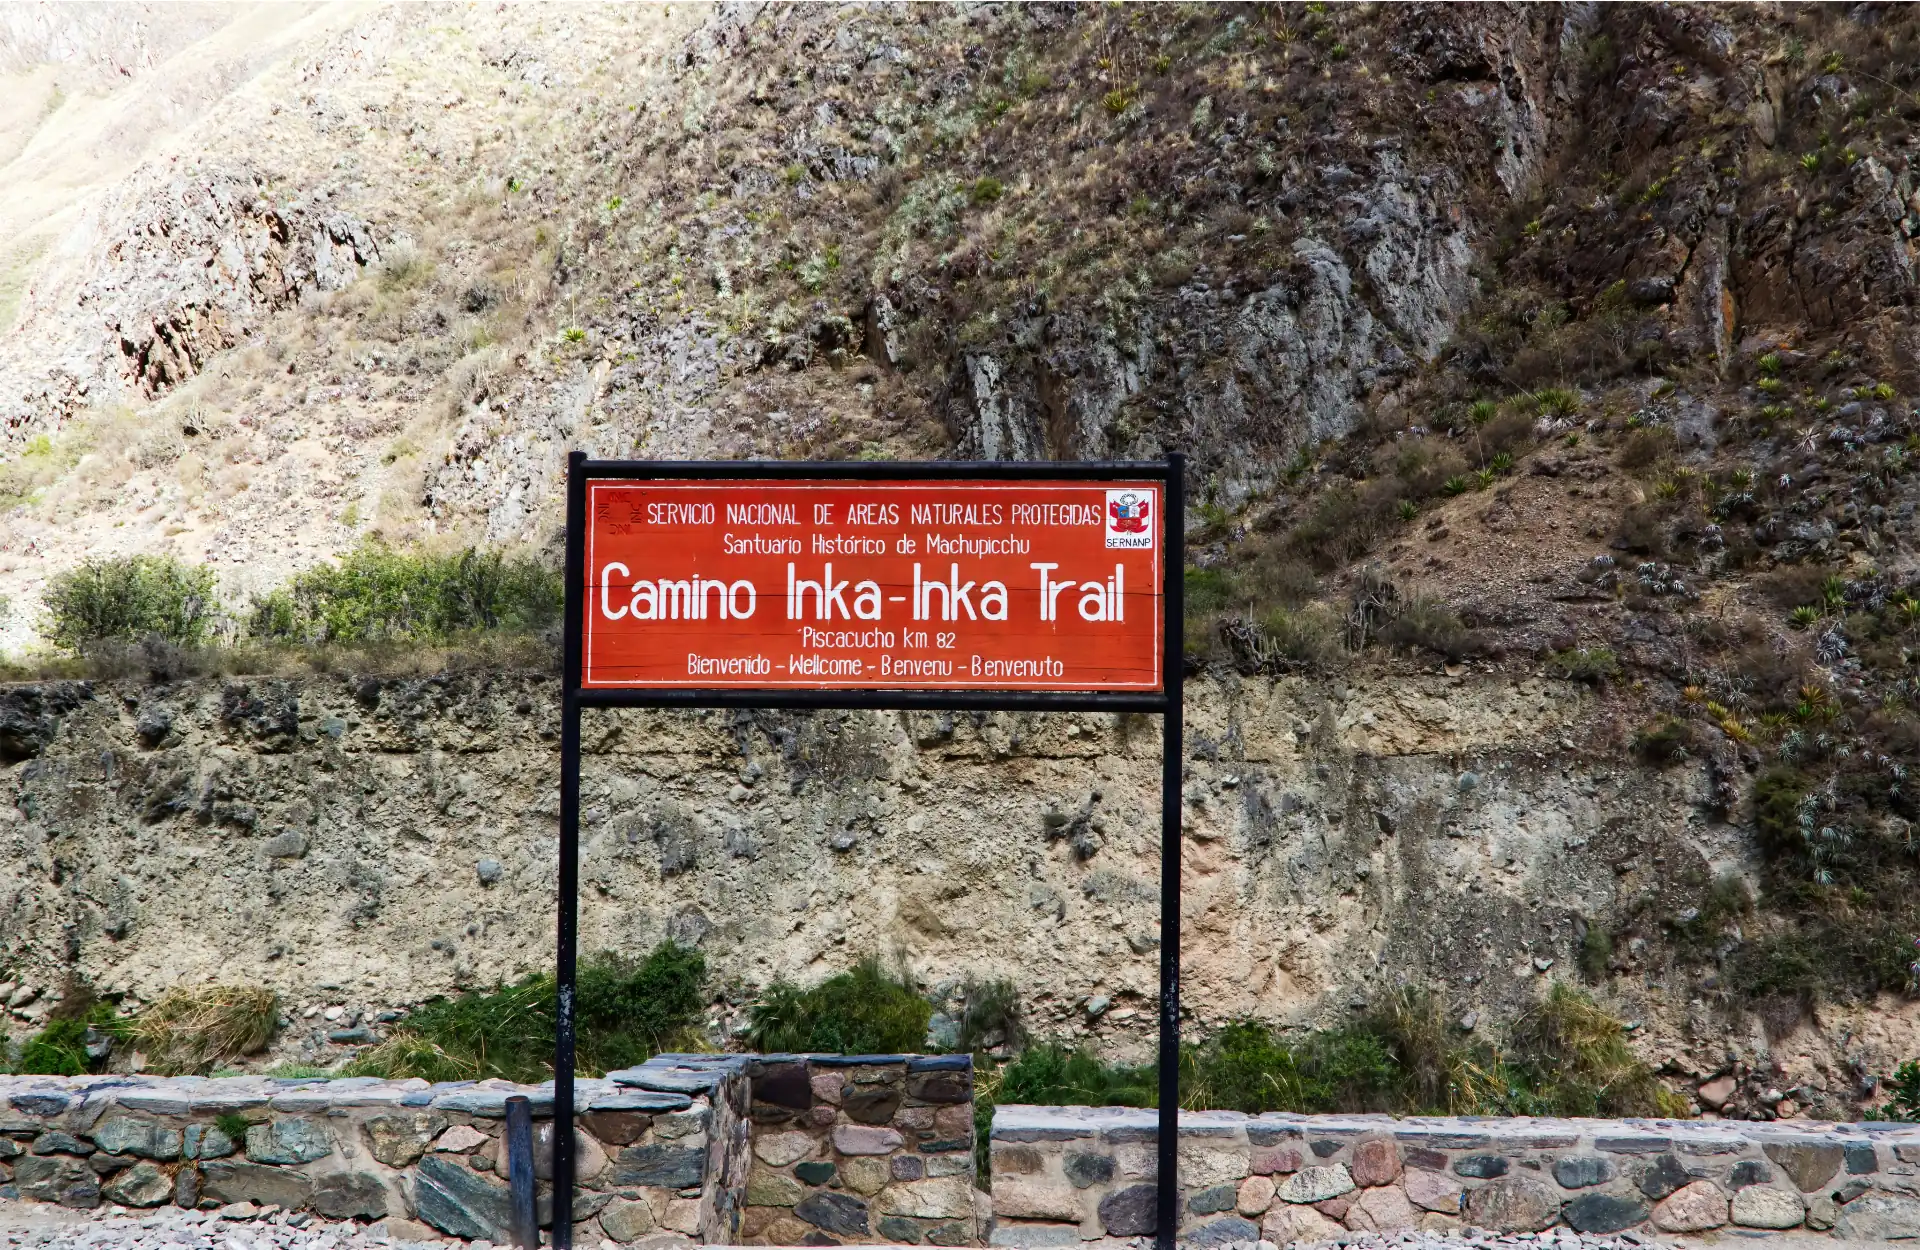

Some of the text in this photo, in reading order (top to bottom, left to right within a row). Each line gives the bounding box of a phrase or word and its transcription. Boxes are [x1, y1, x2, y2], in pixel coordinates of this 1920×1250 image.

[647, 503, 1102, 526] SERVICIO NACIONAL DE AREAS NATURALES PROTEGIDAS
[723, 532, 1030, 560] Santuario Histórico de Machupicchu
[1106, 537, 1151, 548] SERNANP
[601, 561, 757, 621] Camino
[1029, 562, 1125, 623] Trail
[802, 626, 895, 649] Piscacucho
[936, 632, 956, 650] 82
[687, 653, 771, 676] Bienvenido
[789, 653, 863, 676] Wellcome
[881, 654, 953, 677] Benvenu
[971, 655, 1064, 677] Benvenuto
